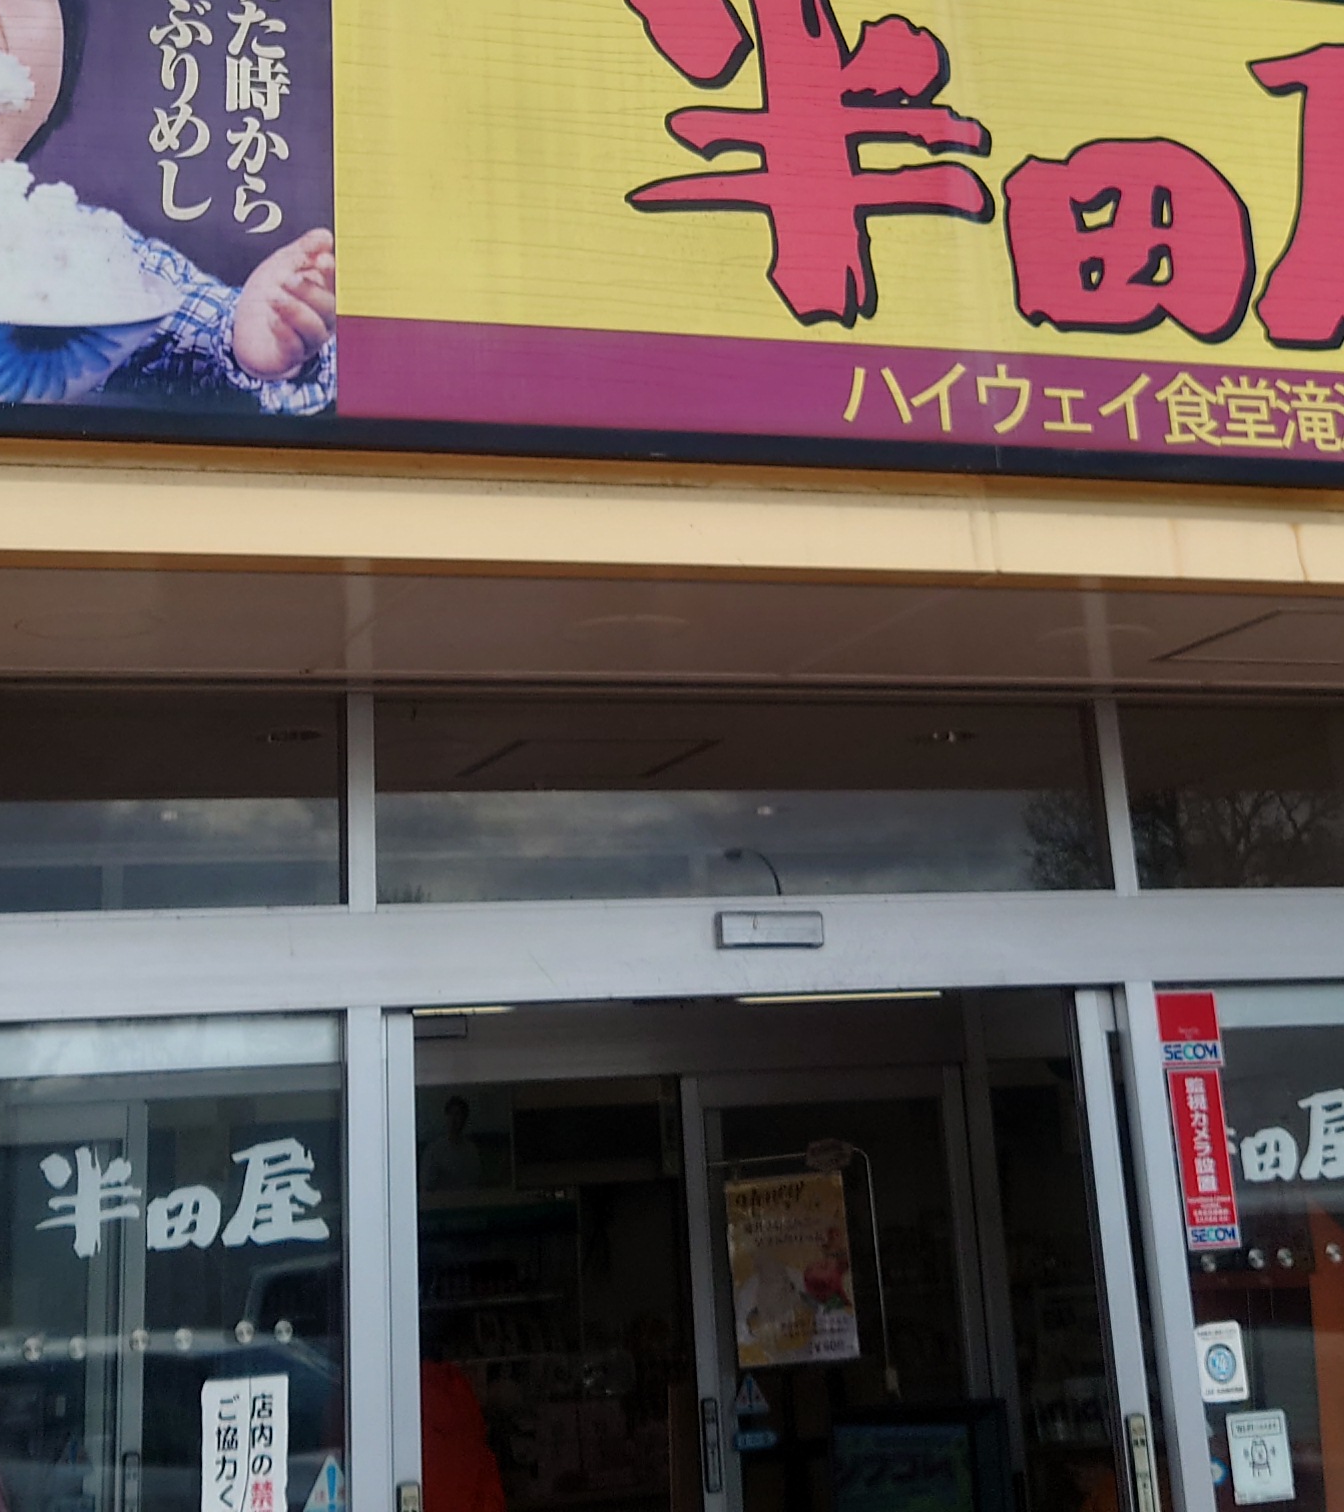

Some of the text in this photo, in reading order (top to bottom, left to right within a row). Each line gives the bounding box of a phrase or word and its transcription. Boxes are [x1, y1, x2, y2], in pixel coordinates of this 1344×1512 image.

[1163, 1041, 1219, 1061] SECOM
[1184, 1076, 1219, 1192] 監視カメラ設置
[34, 1137, 331, 1259] 半田屋
[1191, 1226, 1236, 1243] SECOM
[215, 1394, 240, 1508] ご協力く
[250, 1392, 273, 1512] 店内の禁
